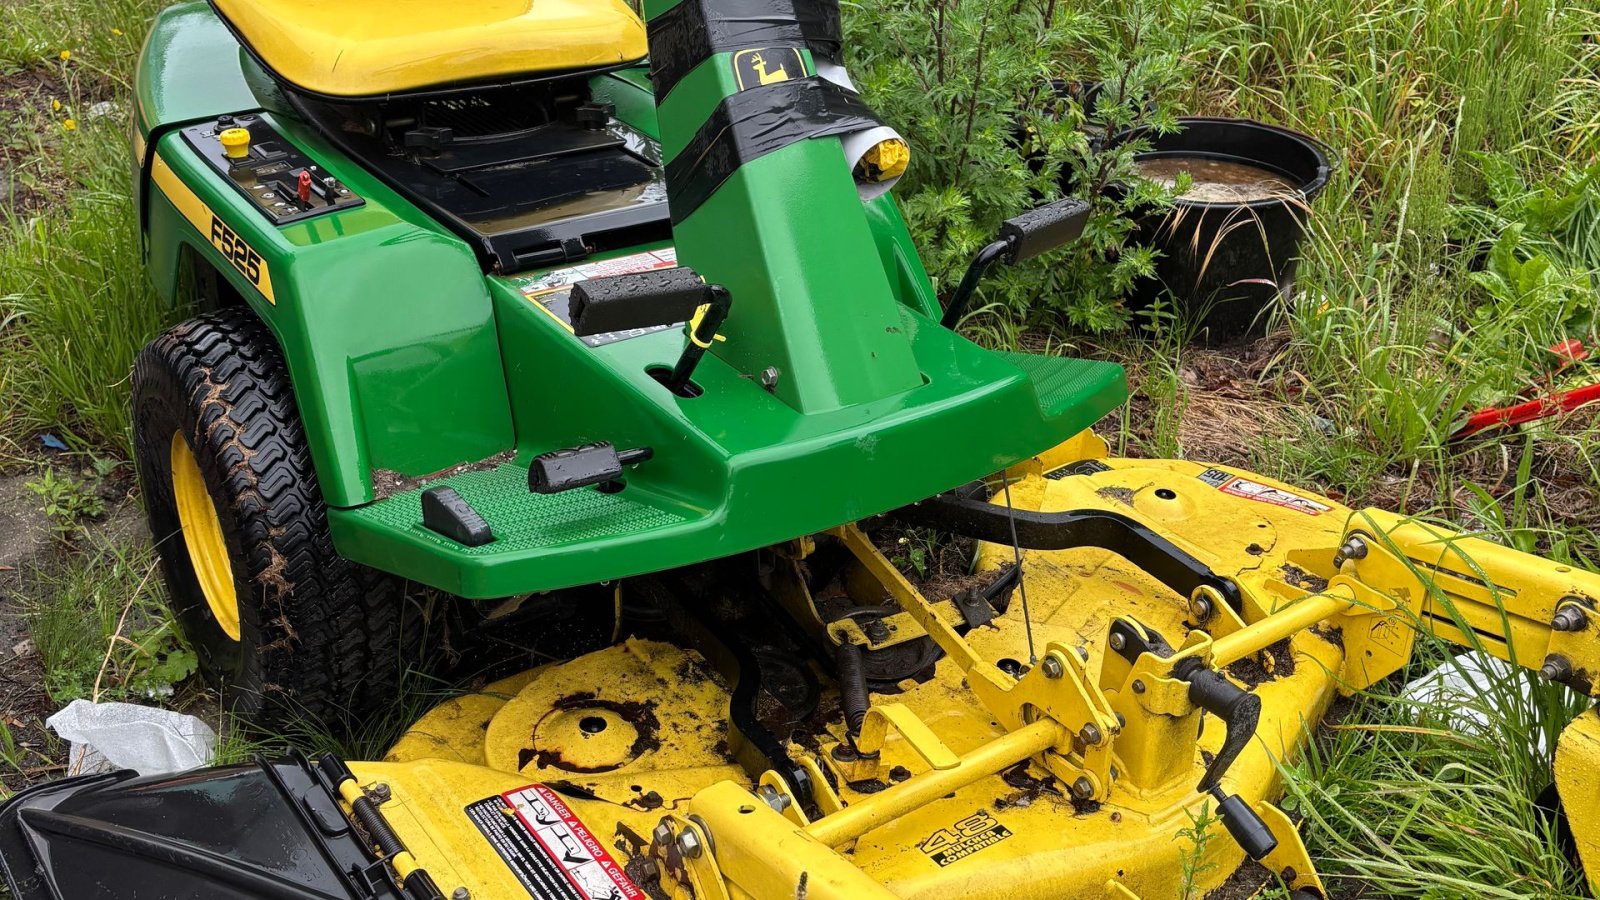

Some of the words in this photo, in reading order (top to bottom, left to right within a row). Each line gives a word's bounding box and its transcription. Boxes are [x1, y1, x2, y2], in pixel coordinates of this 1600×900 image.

[211, 215, 261, 285] F525
[1205, 469, 1230, 482] 105
[543, 792, 571, 819] DANGER
[574, 827, 604, 857] PELIGRO
[608, 867, 638, 898] GEFAHR
[920, 811, 998, 855] 48
[939, 830, 1012, 866] COMPATIBLE
[942, 830, 997, 857] MULCHER
